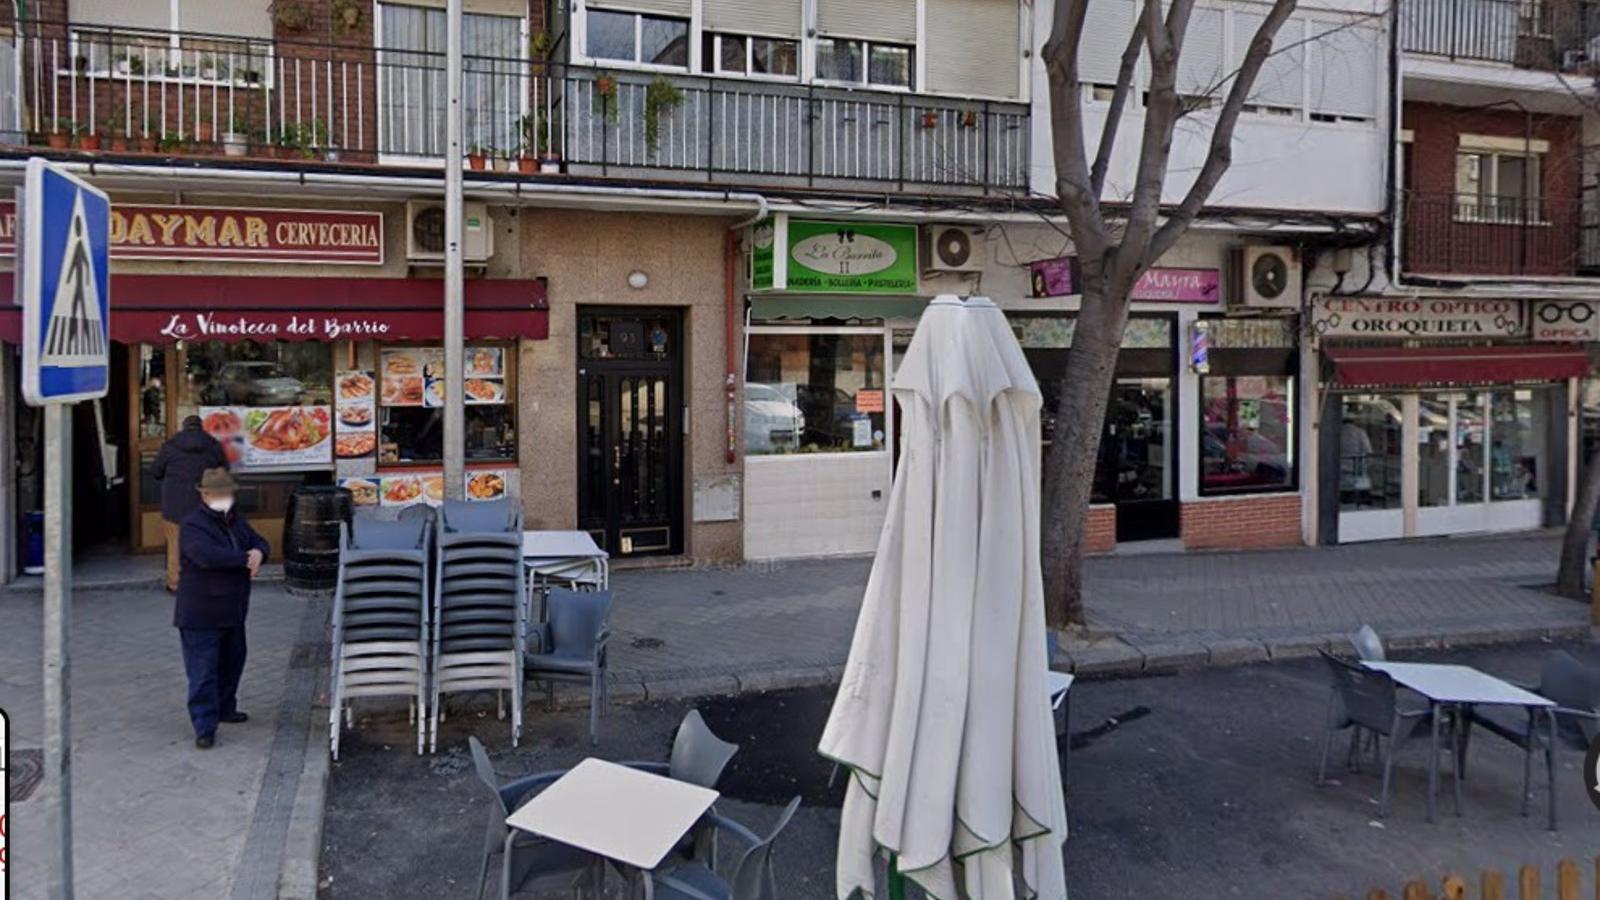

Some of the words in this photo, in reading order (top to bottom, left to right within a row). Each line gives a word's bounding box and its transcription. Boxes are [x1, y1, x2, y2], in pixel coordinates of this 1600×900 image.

[111, 210, 269, 248] DAYMAR
[276, 221, 379, 247] CERVECERIA
[1324, 299, 1420, 313] CENTRO
[1430, 300, 1510, 314] OPTICO
[160, 314, 198, 339] La
[196, 311, 279, 334] Vinoteca
[286, 316, 316, 335] del
[323, 318, 390, 339] Barrio
[1352, 318, 1483, 335] OROQUIETA
[1540, 329, 1592, 338] OPTICA
